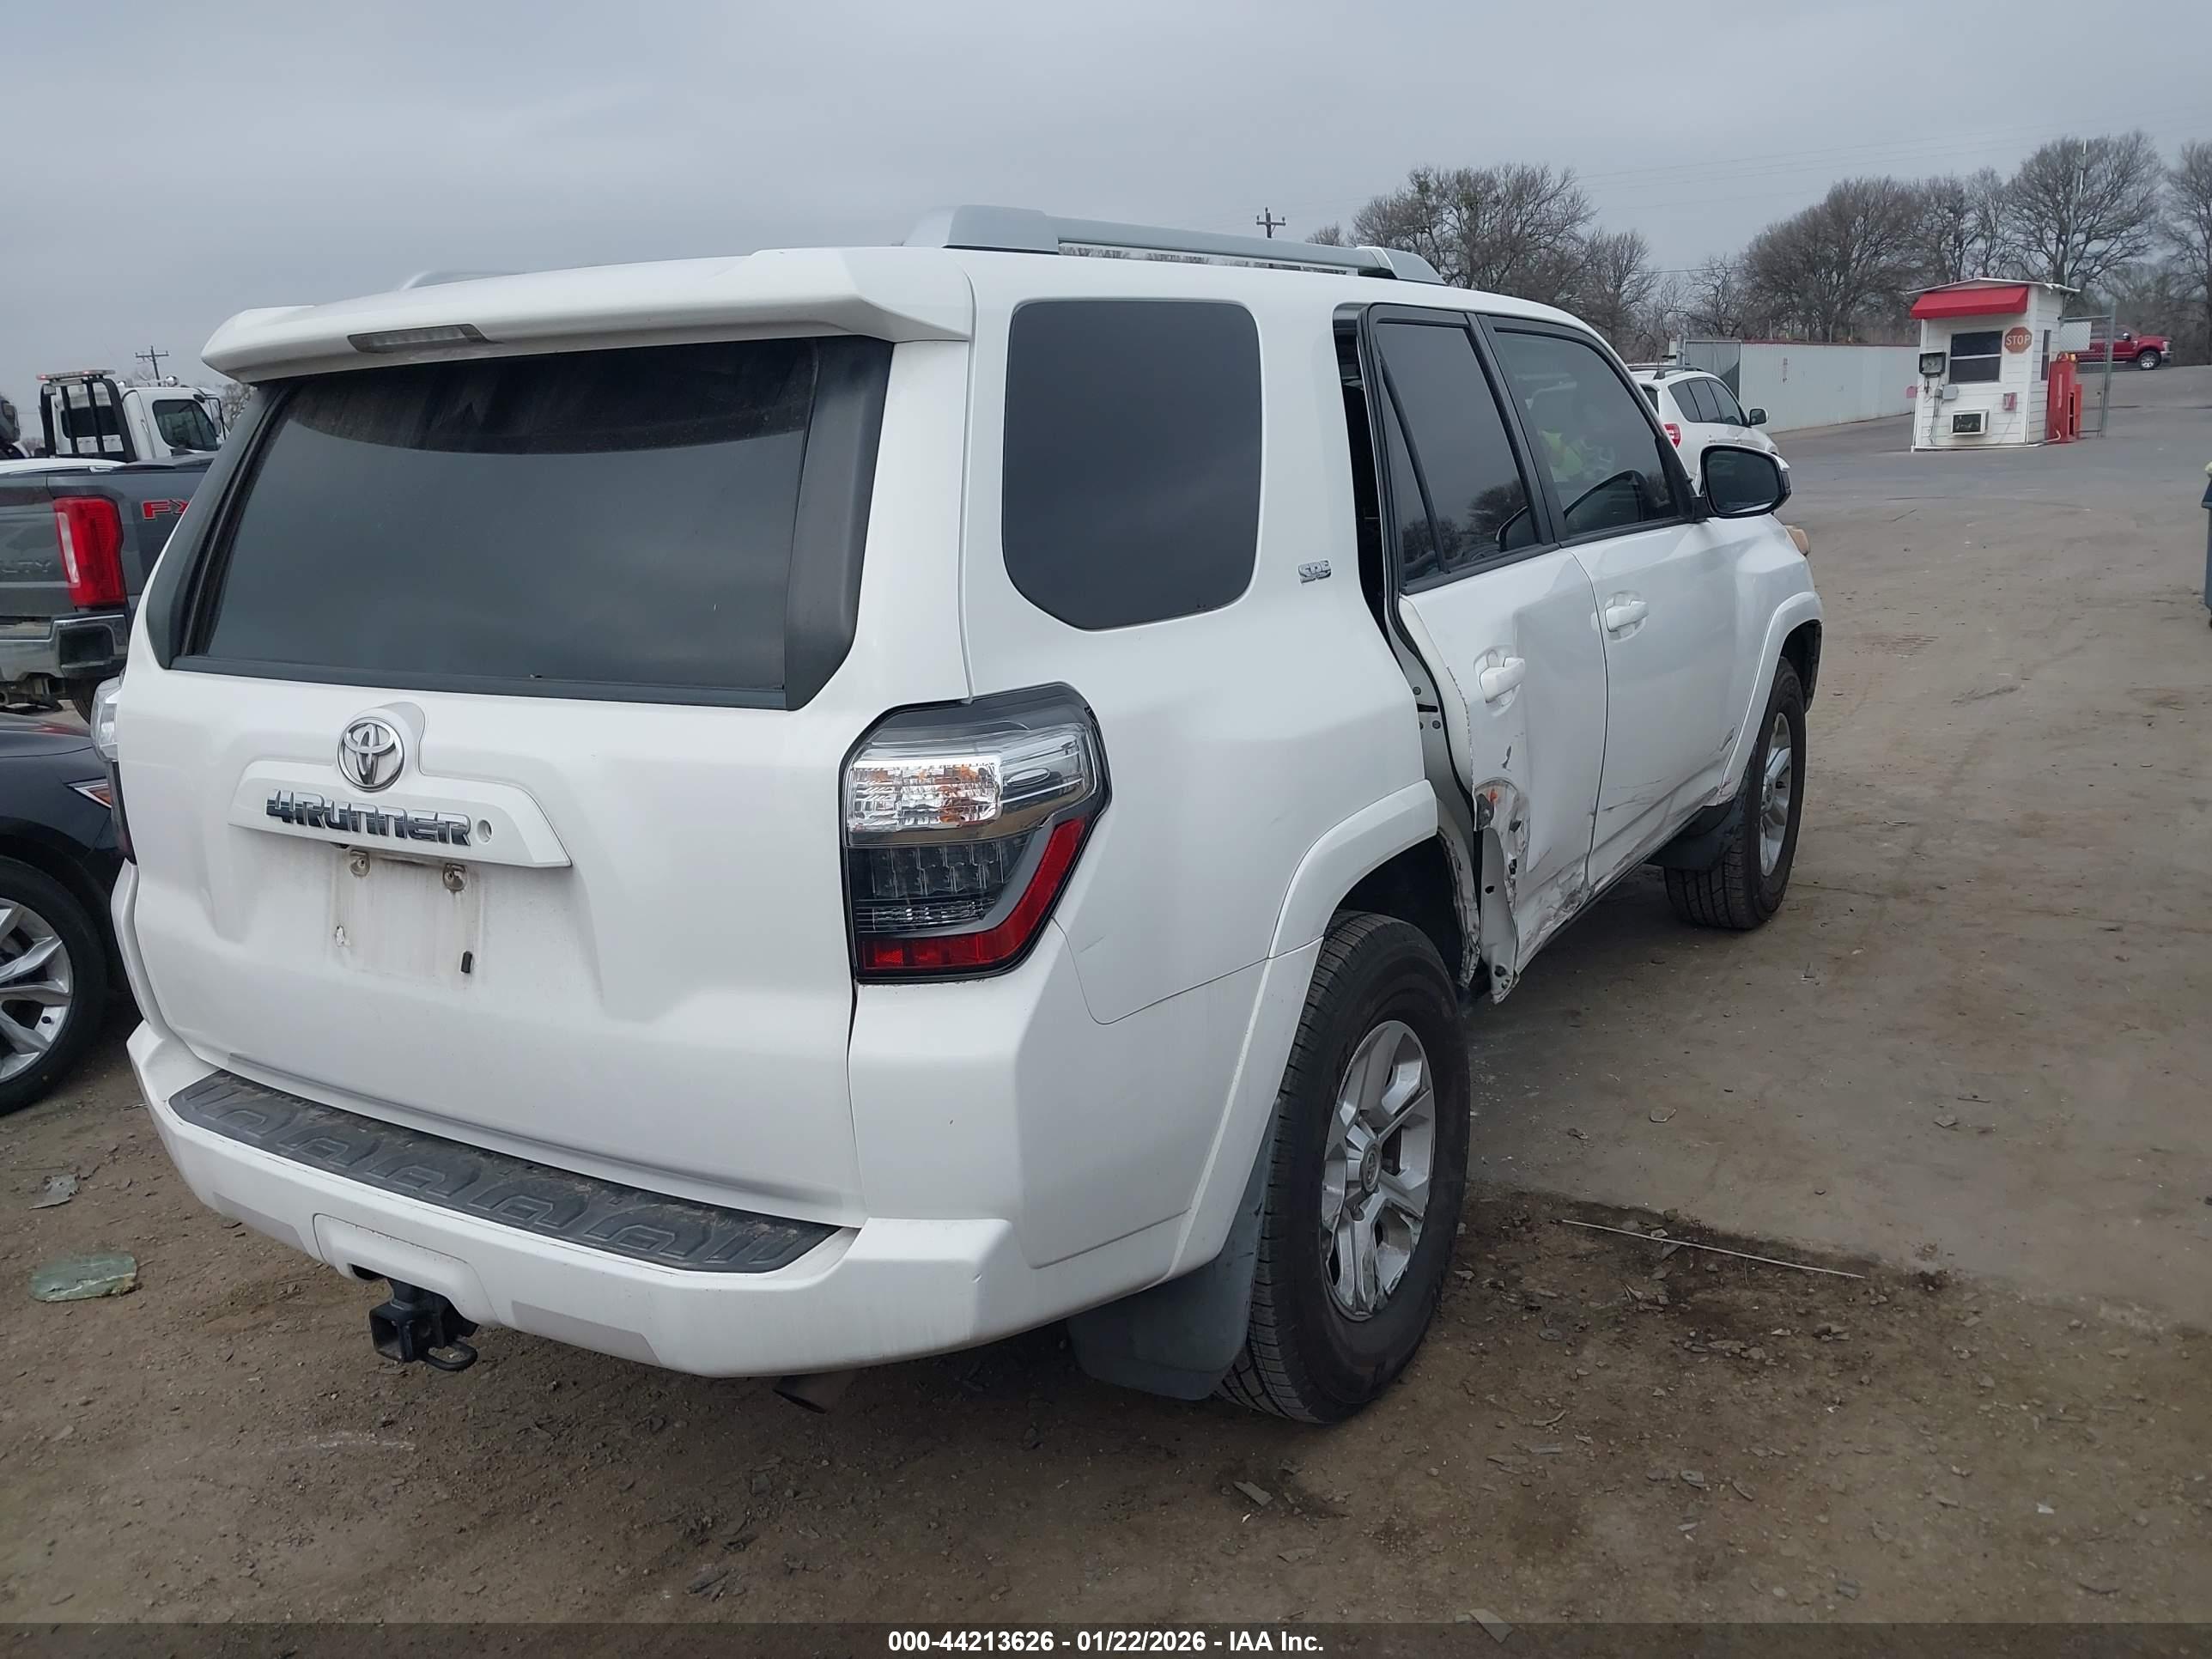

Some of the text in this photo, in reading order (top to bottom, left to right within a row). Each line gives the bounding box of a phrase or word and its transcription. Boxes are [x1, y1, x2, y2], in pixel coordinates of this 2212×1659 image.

[2005, 335, 2031, 345] STOP
[142, 499, 189, 520] FX
[266, 789, 471, 847] 4RUNNER
